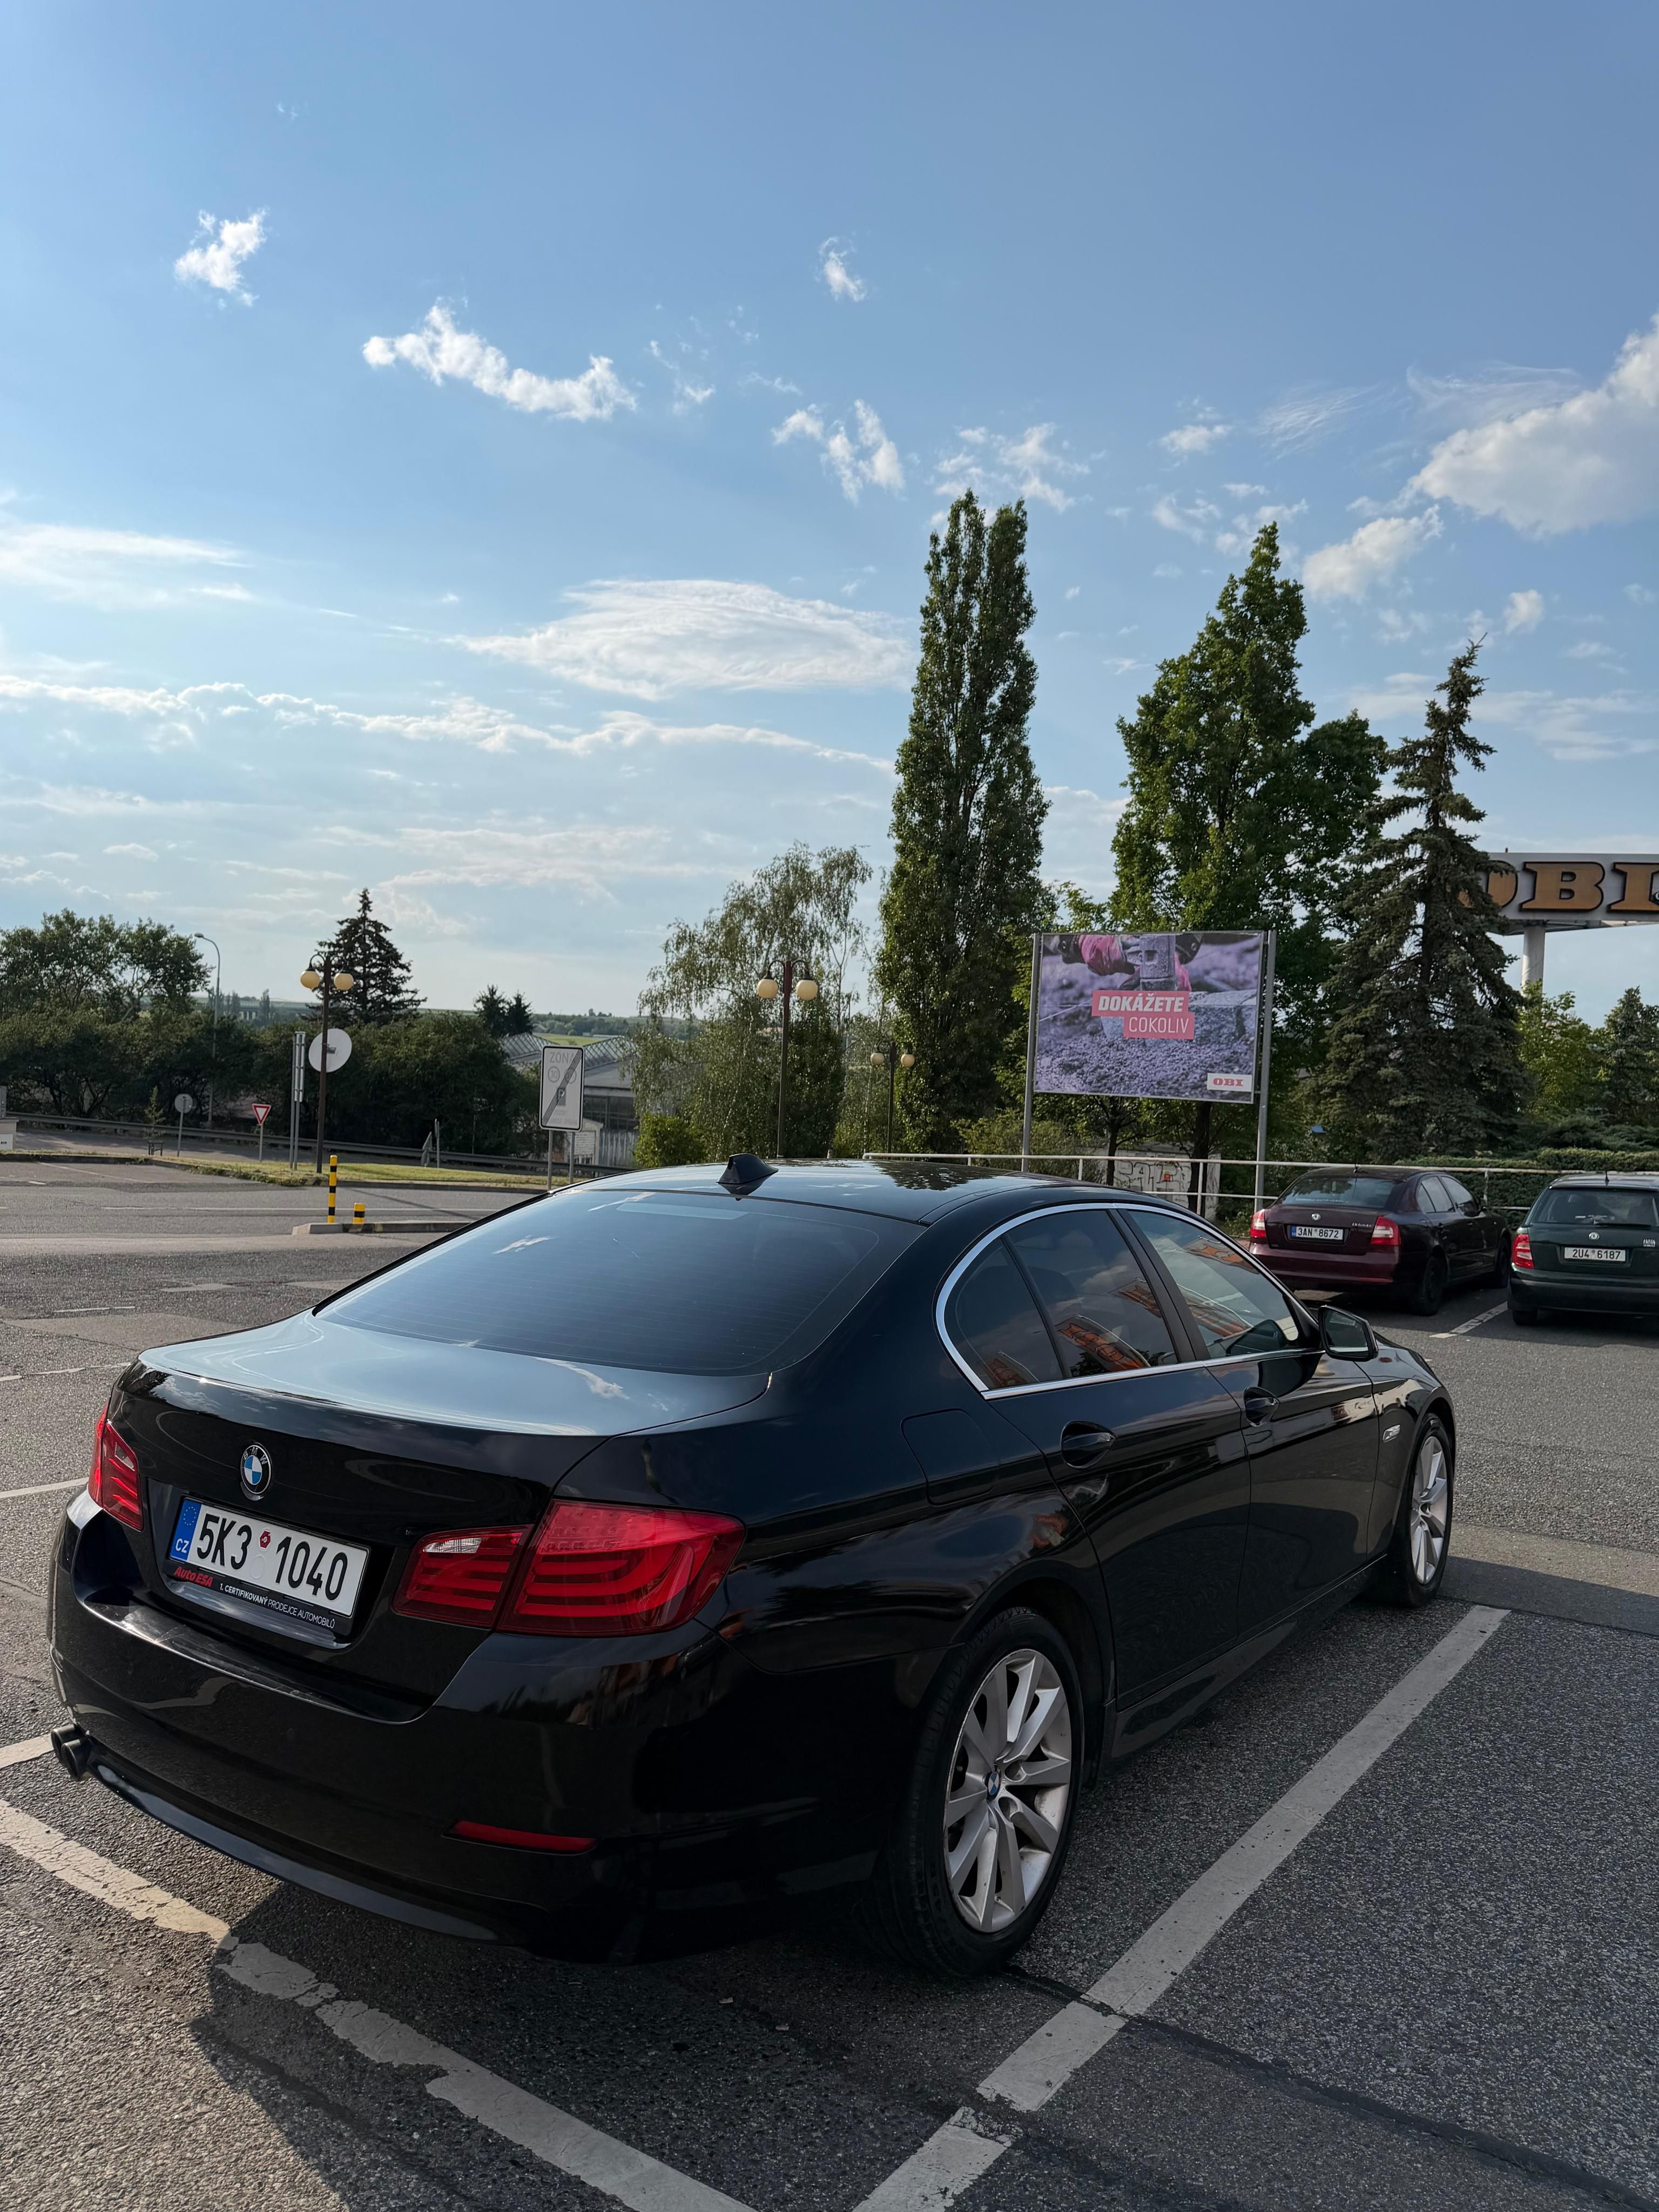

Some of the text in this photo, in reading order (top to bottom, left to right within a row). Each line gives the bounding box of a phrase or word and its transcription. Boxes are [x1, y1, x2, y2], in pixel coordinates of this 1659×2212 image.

[1098, 993, 1185, 1013] DOKÁŽETE
[1129, 1016, 1189, 1034] COKOLIV
[1213, 1077, 1244, 1087] OBI
[1298, 1228, 1313, 1237] 3AN
[1318, 1229, 1339, 1238] 8672
[1572, 1249, 1621, 1260] 2U4 6187
[243, 1447, 268, 1465] BMW
[176, 1538, 190, 1554] CZ
[197, 1513, 348, 1601] 5K3 1040
[225, 1585, 268, 1605] CERTIFIKOVANÝ
[268, 1599, 298, 1616] PRODEJCE
[297, 1609, 335, 1629] AUTOMOBILŮ
